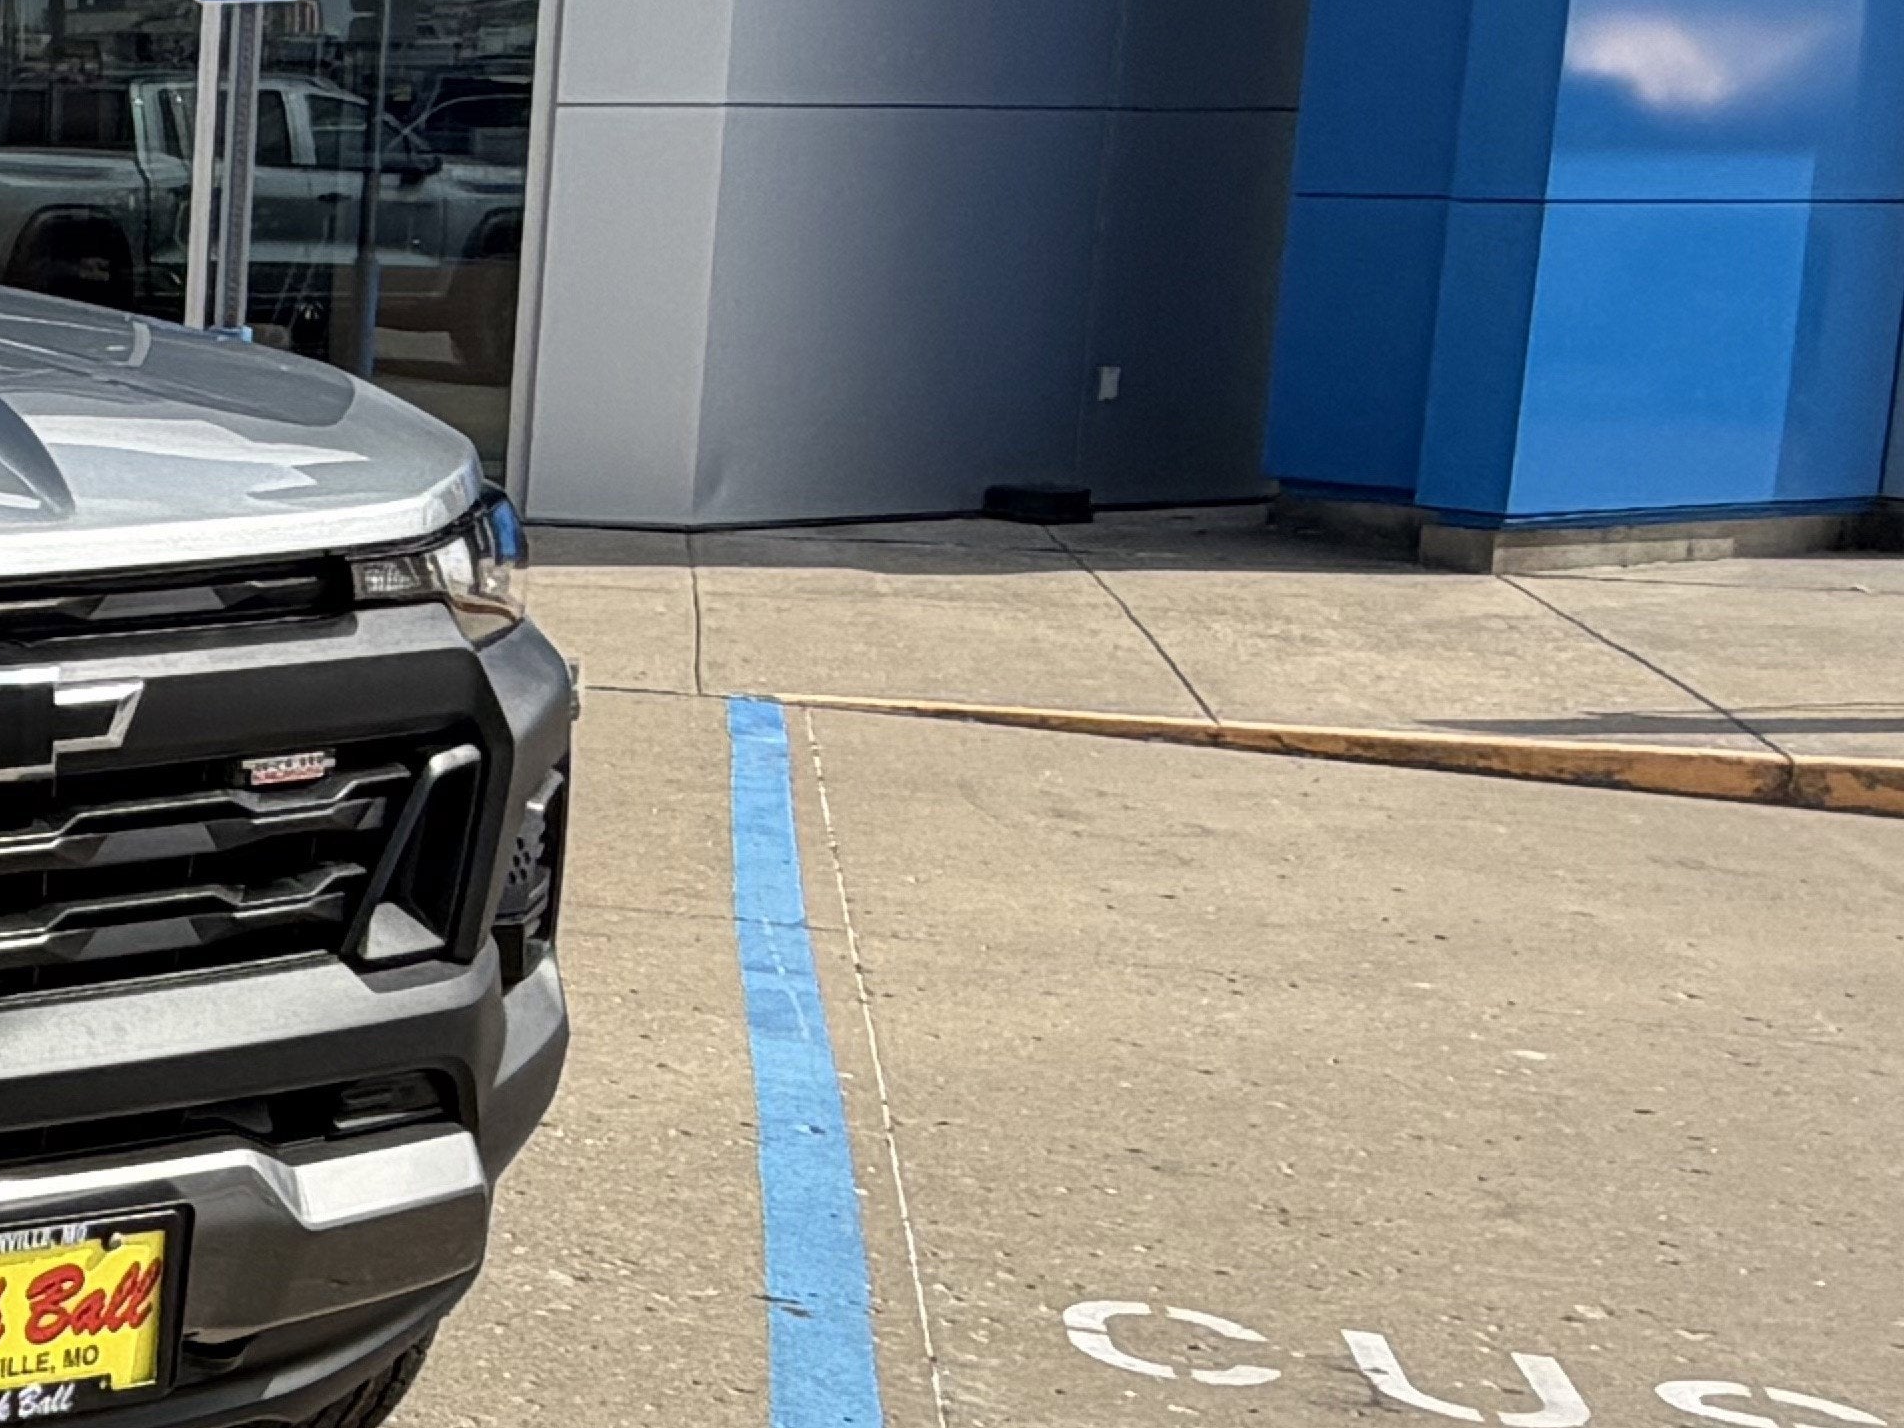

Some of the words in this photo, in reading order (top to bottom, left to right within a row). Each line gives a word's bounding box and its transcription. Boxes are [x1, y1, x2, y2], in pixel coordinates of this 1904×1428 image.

[26, 1257, 162, 1344] Ball
[63, 1344, 100, 1369] MO
[18, 1382, 75, 1420] Ball
